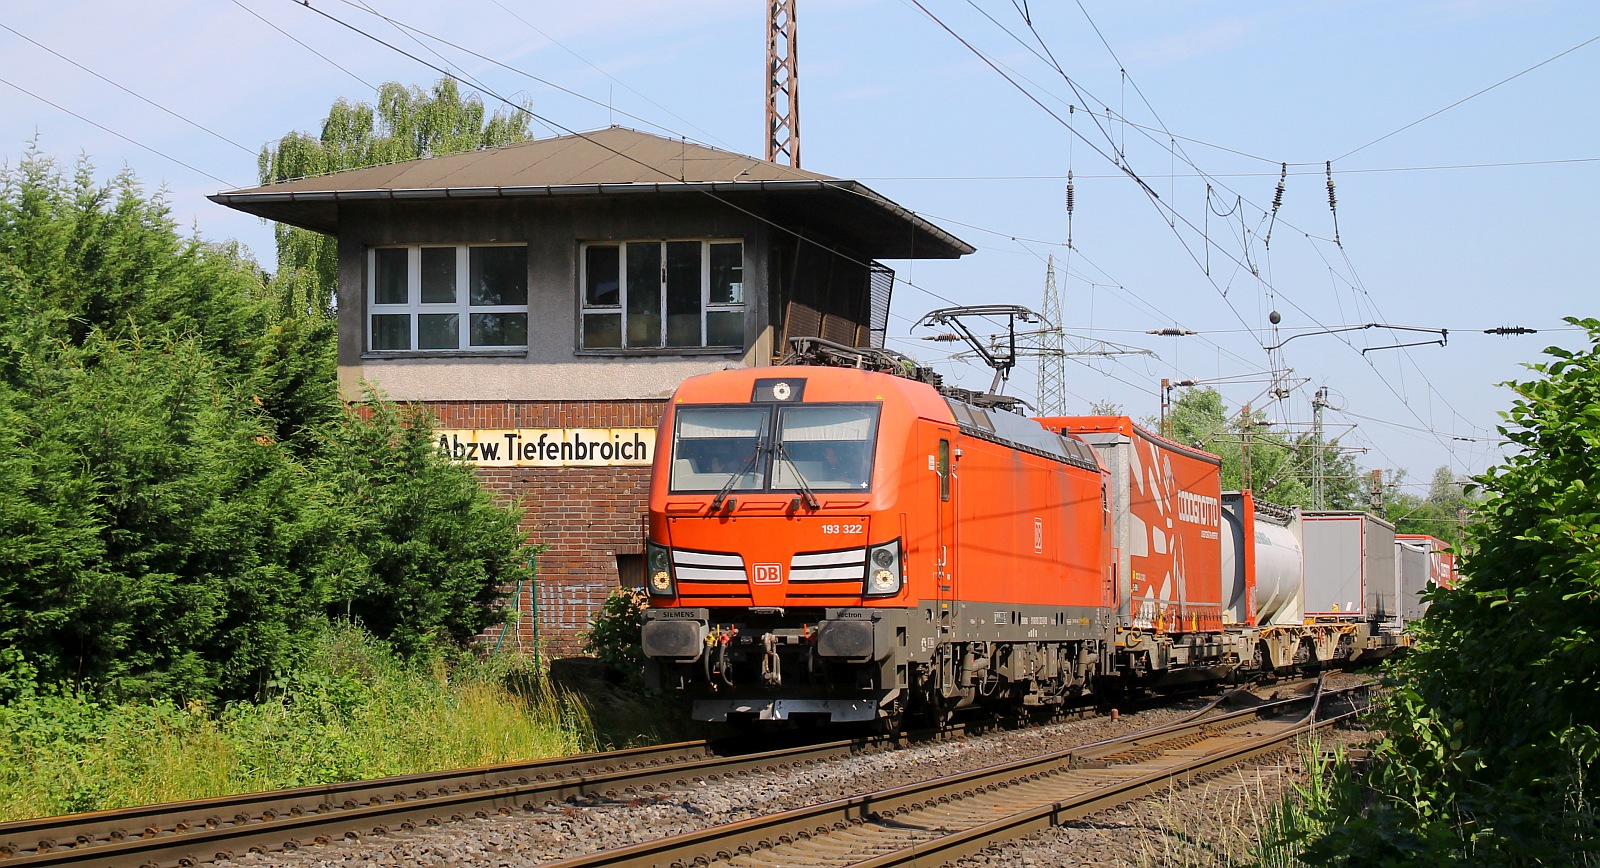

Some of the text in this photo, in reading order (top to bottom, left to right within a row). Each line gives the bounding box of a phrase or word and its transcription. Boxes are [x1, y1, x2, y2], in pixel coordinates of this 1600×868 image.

[440, 433, 647, 461] Abzw. Tiefenbroich
[821, 524, 863, 534] 193 322
[756, 566, 779, 581] DB
